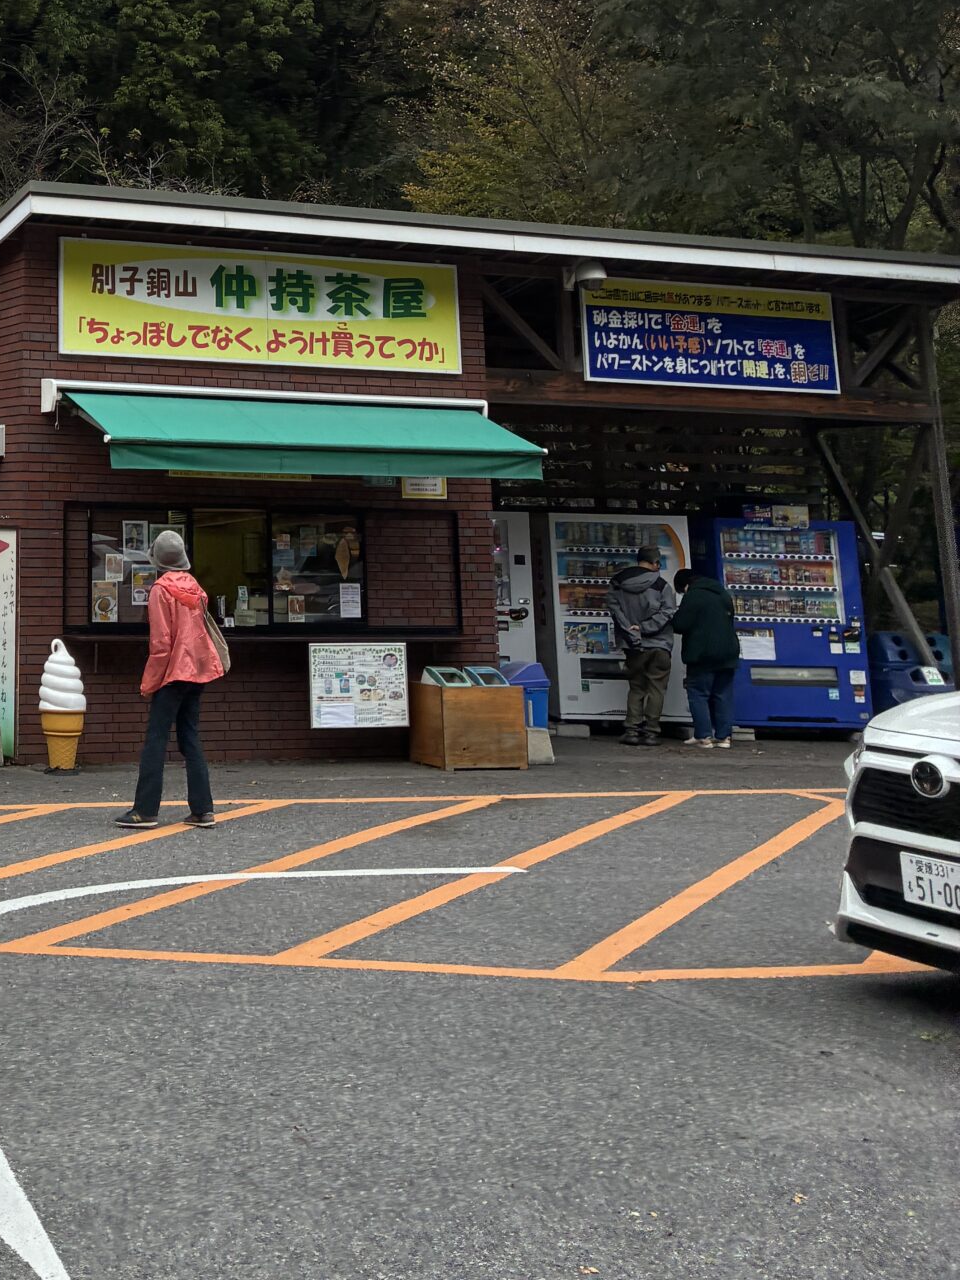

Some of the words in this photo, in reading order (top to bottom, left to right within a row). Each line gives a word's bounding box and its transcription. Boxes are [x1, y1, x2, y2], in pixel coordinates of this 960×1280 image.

[90, 263, 198, 299] 別子銅山
[209, 264, 427, 319] 仲持茶屋
[933, 863, 949, 879] 331
